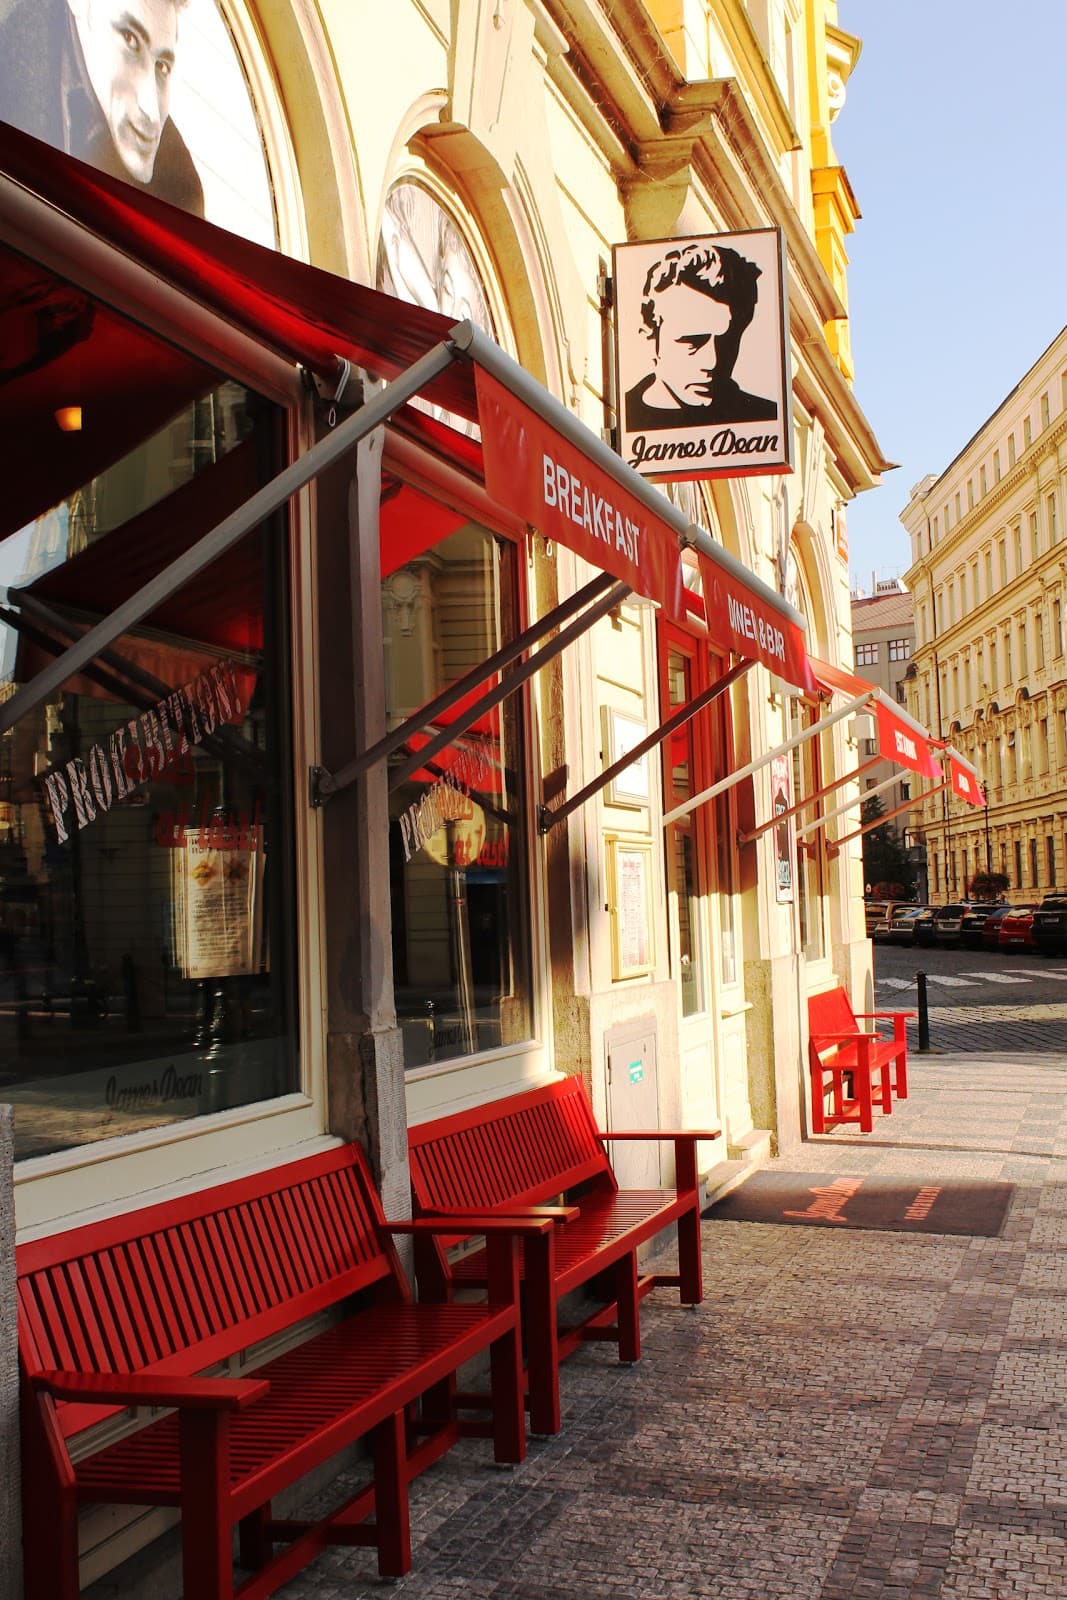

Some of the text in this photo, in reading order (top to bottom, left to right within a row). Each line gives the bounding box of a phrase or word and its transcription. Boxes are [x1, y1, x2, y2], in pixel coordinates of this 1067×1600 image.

[628, 428, 779, 469] James Dean
[542, 454, 640, 567] BREAKFAST
[758, 616, 768, 650] &
